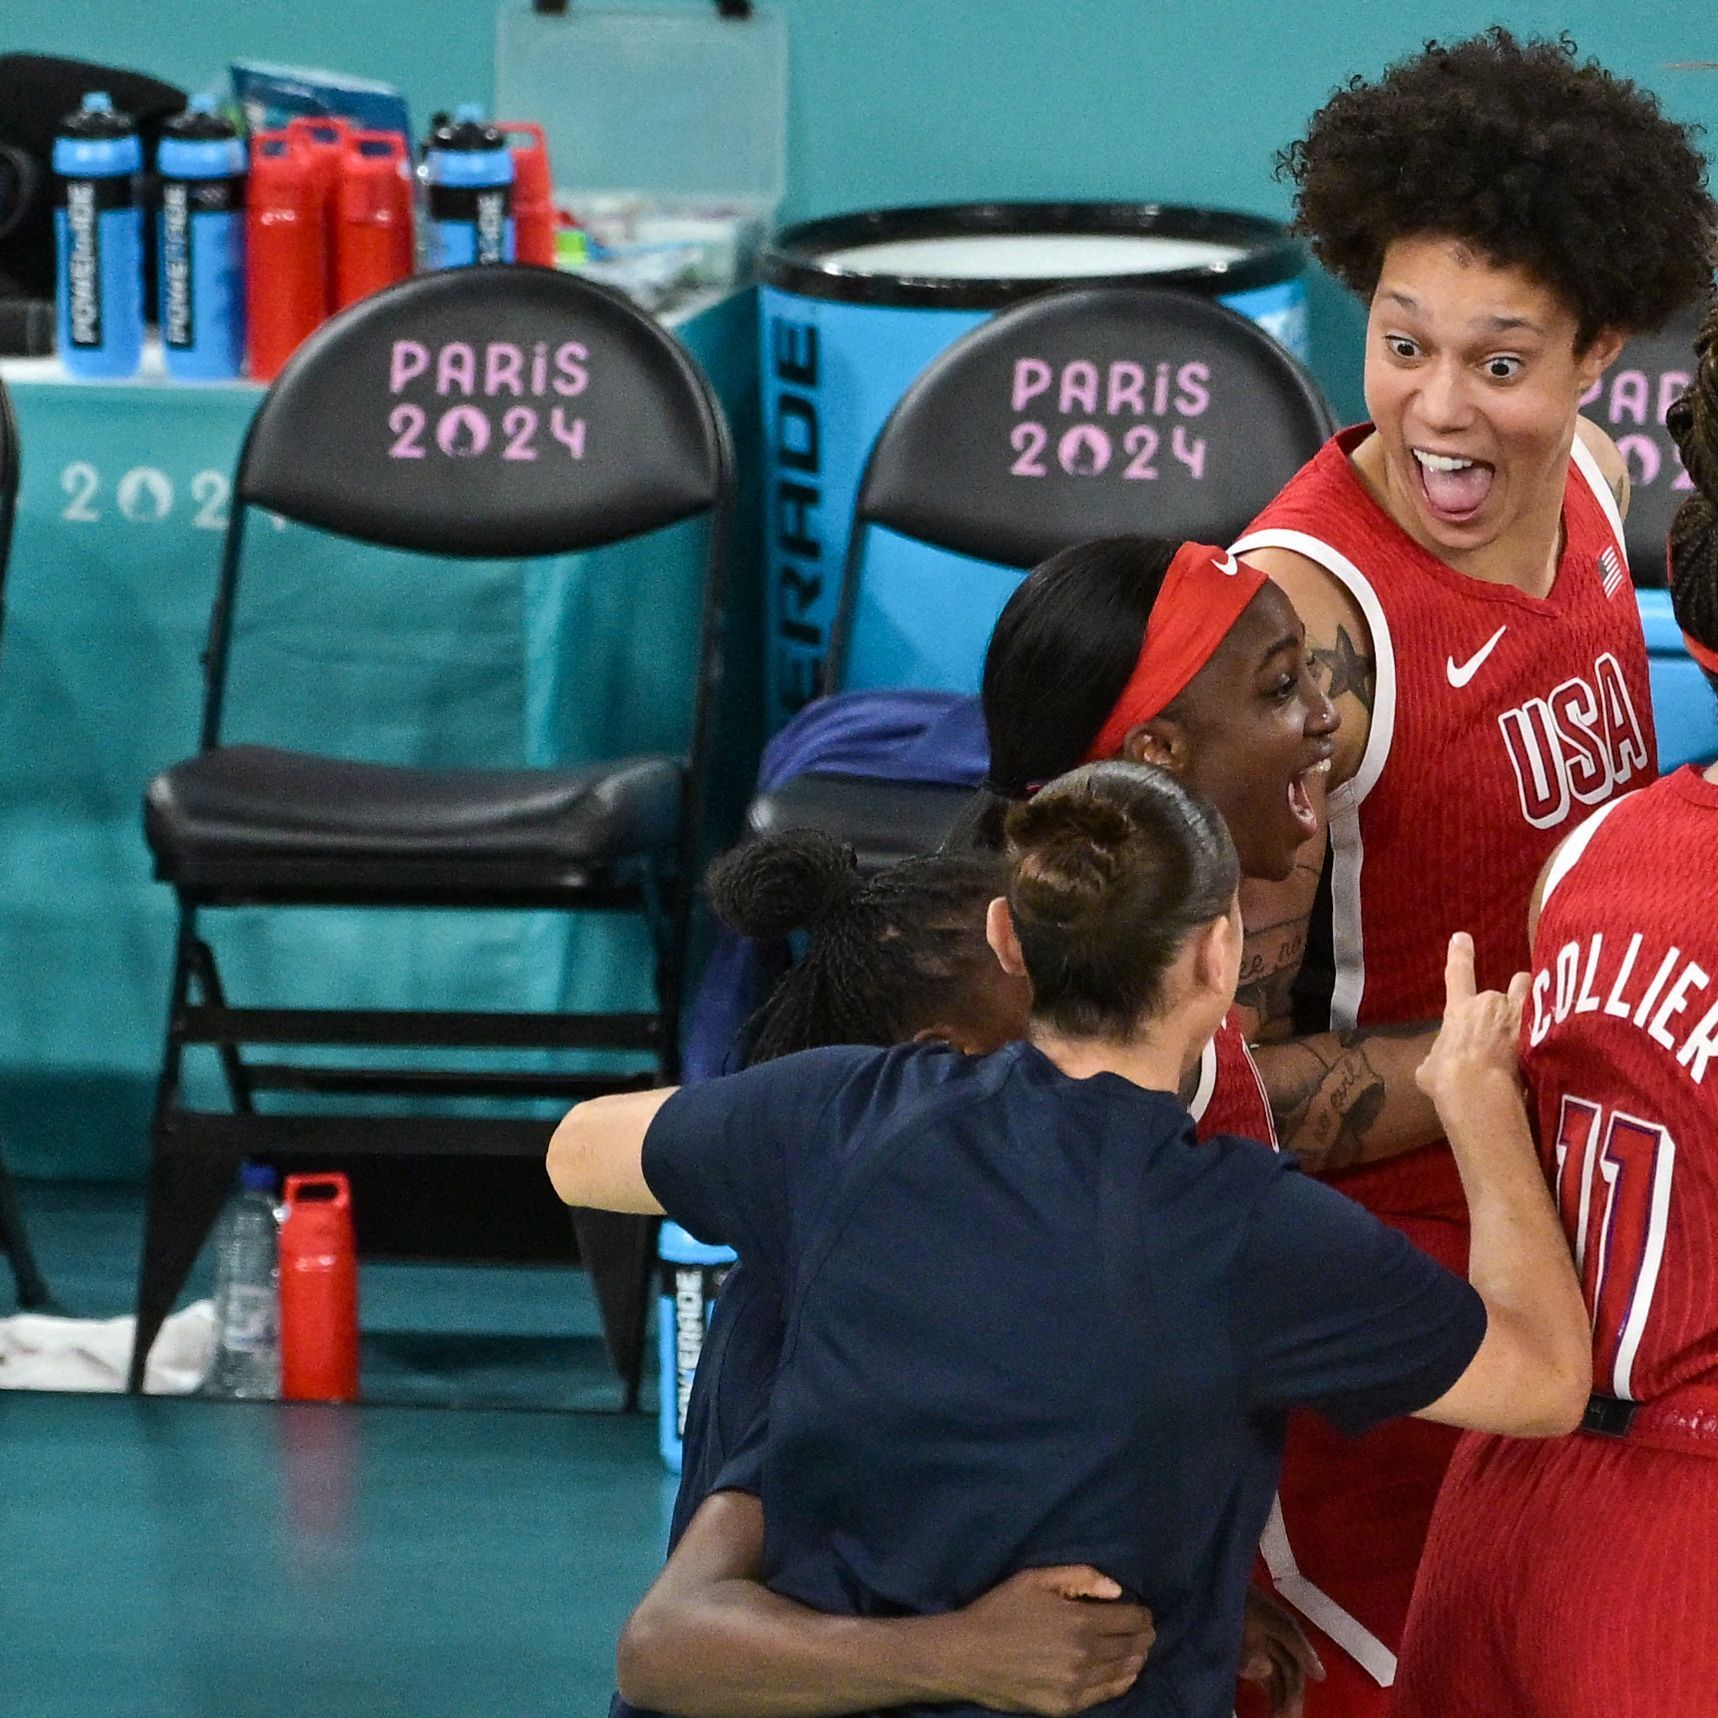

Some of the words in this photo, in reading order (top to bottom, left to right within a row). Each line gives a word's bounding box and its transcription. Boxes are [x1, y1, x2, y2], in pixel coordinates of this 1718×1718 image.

[390, 405, 586, 460] 2024
[1011, 422, 1206, 480] 2024
[1500, 652, 1650, 830] USA
[1556, 1093, 1676, 1402] 11
